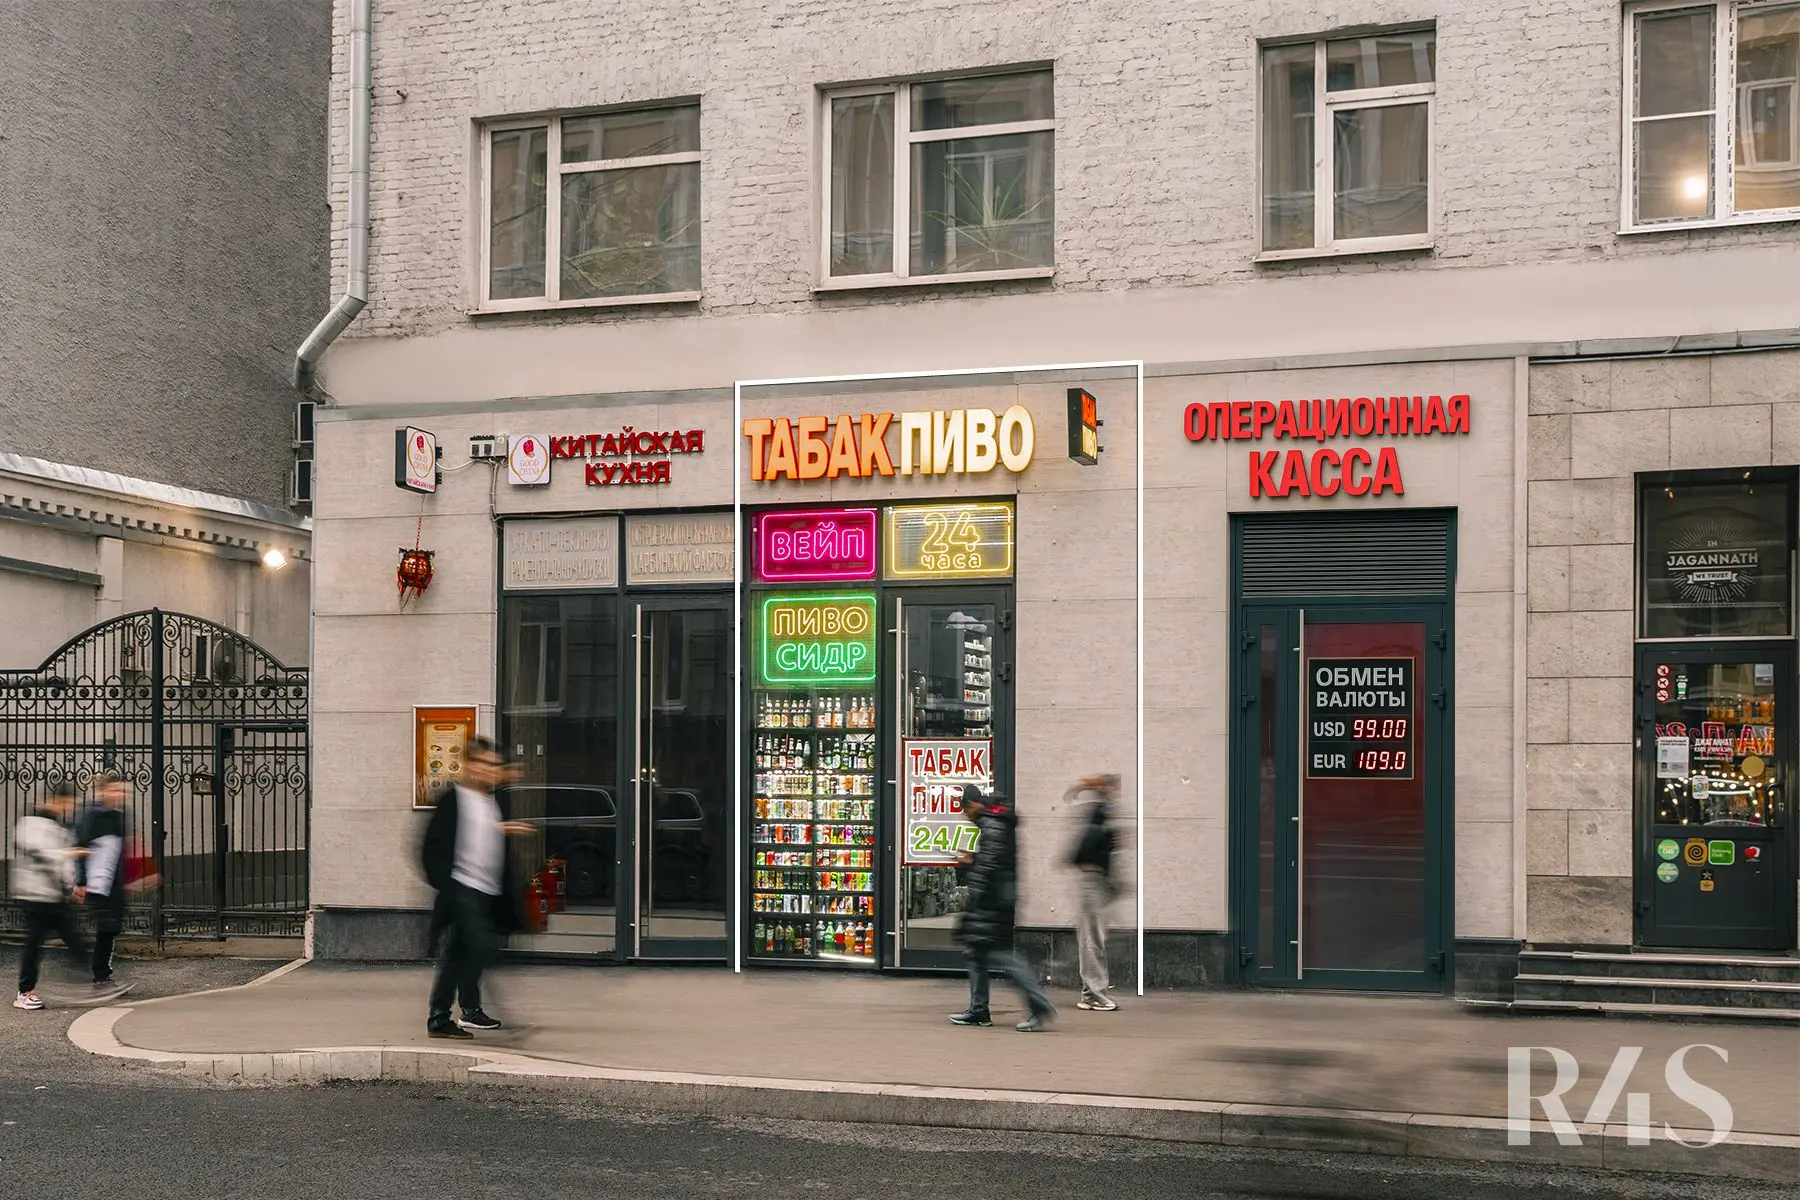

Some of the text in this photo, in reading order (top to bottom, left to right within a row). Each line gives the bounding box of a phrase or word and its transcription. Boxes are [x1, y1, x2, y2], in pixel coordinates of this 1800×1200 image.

[1183, 395, 1470, 441] ОПЕРАЦИОННАЯ
[552, 426, 704, 458] КИТАЙСКАЯ
[744, 412, 895, 481] ТАБАК
[901, 405, 1035, 474] ПИВО
[585, 461, 671, 485] КУХНЯ
[1249, 446, 1404, 497] КАССА
[771, 522, 865, 560] ВЕЙП
[921, 511, 980, 554] 24
[920, 552, 982, 570] часа
[1667, 553, 1758, 566] JAGANNATH
[1709, 571, 1729, 579] TRUST
[774, 606, 868, 635] ПИВО
[775, 642, 867, 674] СИДР
[1316, 667, 1404, 687] ОБМЕН
[1316, 691, 1406, 707] ВАЛЮТЫ
[1313, 719, 1406, 738] USD 99.00
[909, 748, 986, 776] ТАБАК
[1313, 751, 1406, 770] EUR 109.0
[911, 785, 965, 814] ПИВ
[913, 826, 981, 852] 24/7
